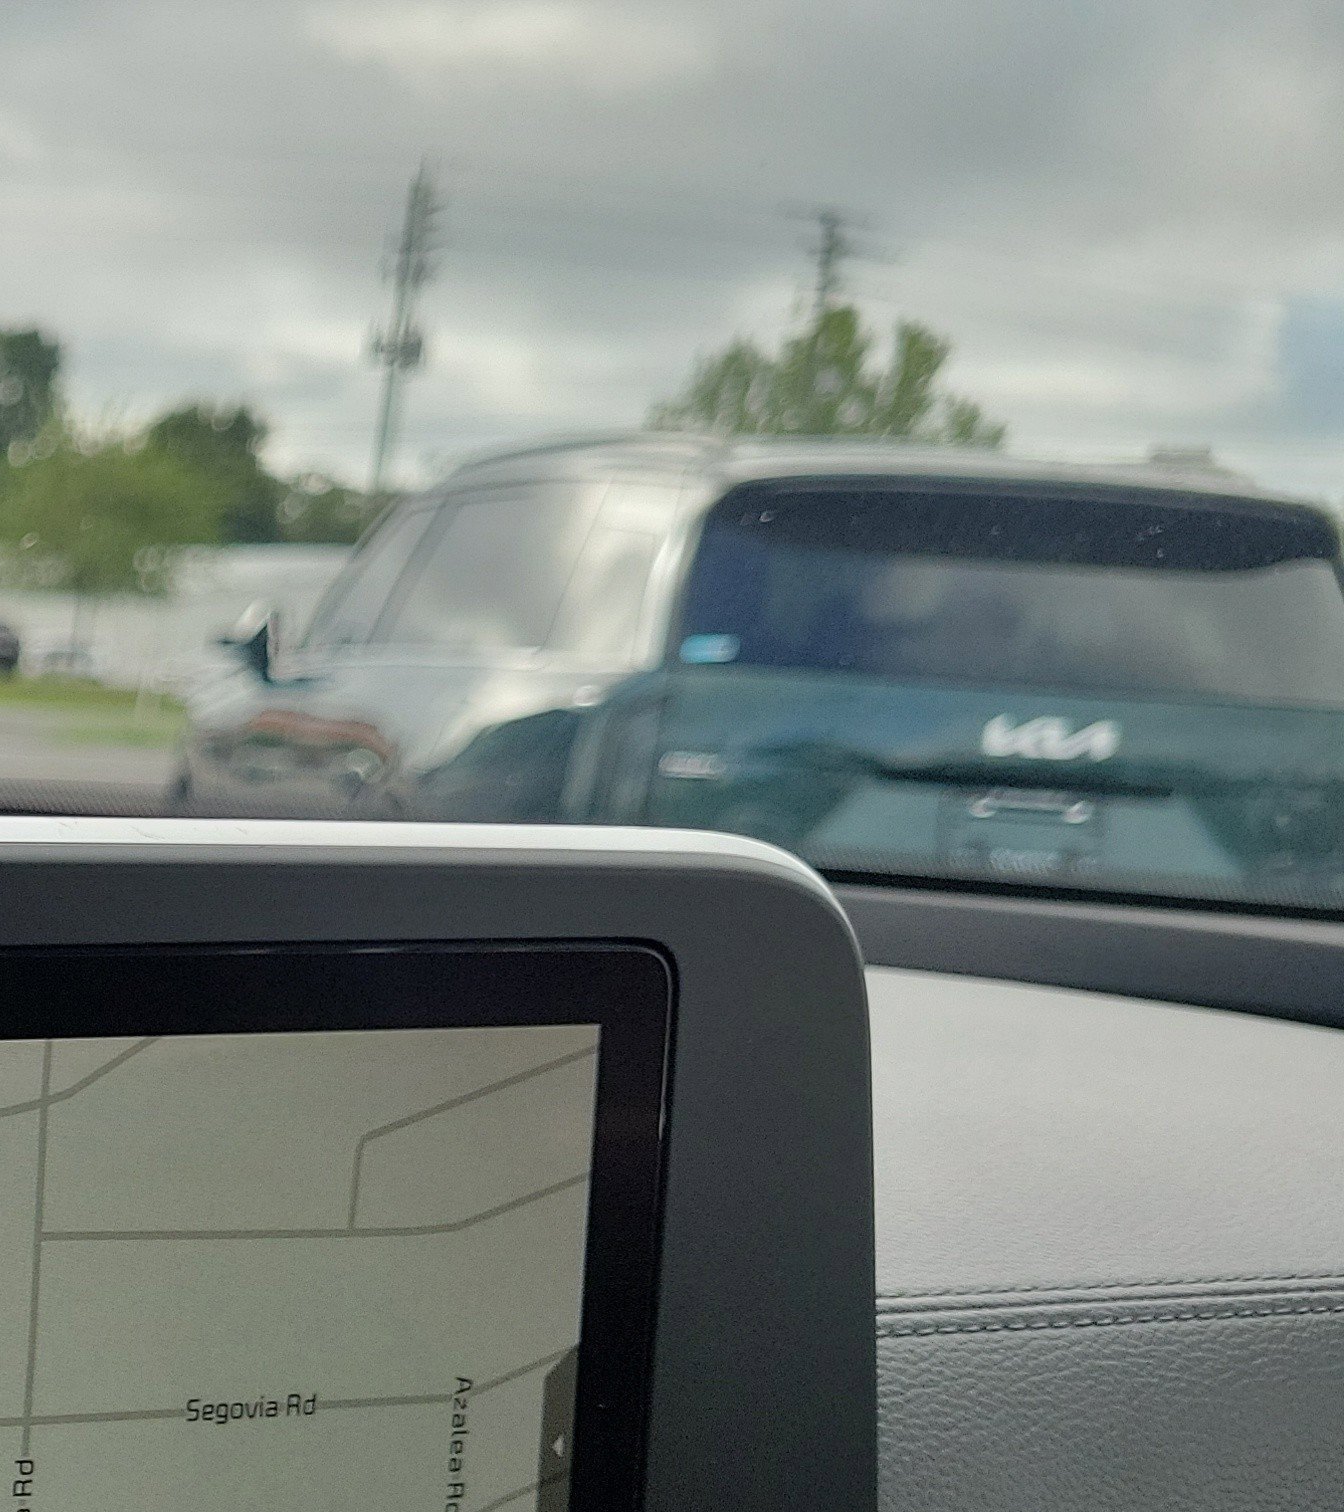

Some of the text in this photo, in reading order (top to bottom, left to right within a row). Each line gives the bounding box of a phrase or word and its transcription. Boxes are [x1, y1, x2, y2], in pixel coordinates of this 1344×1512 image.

[185, 1393, 317, 1425] Segovia Rd
[449, 1377, 473, 1474] Azalea
[12, 1458, 36, 1499] Rd
